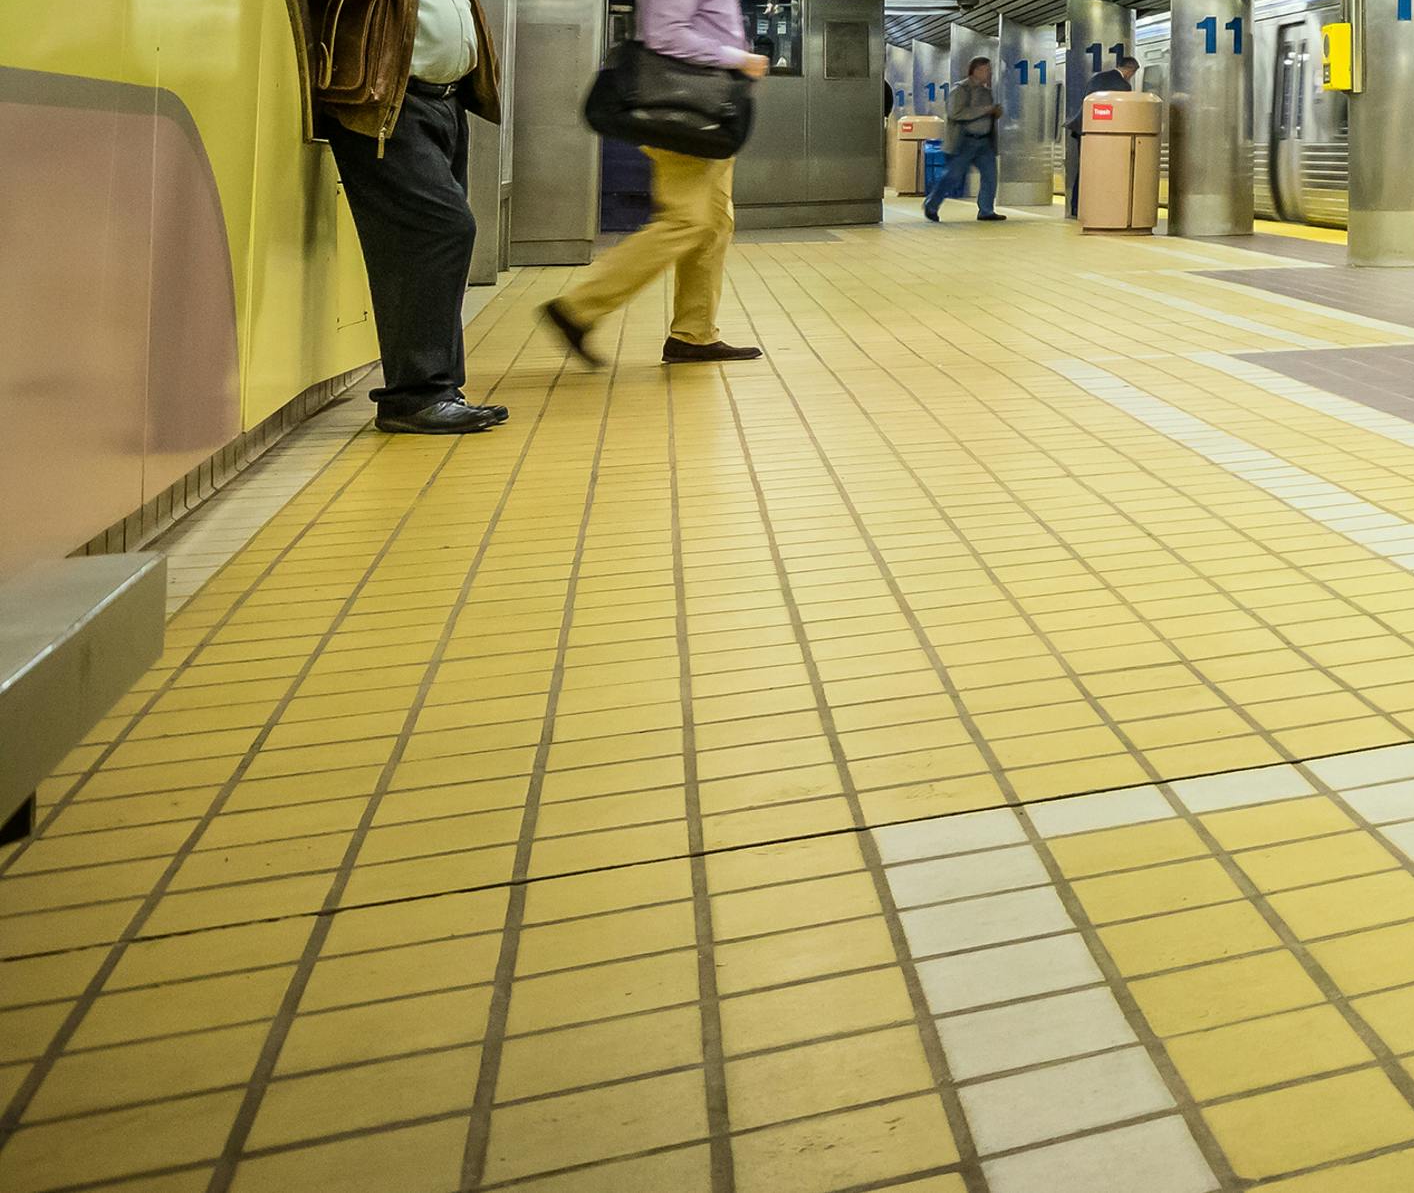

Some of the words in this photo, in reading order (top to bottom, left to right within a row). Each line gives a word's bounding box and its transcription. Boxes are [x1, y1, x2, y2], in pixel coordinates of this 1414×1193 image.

[1195, 16, 1243, 55] 11
[1086, 42, 1125, 73] 11
[1014, 59, 1047, 86] 11
[925, 82, 950, 104] 11
